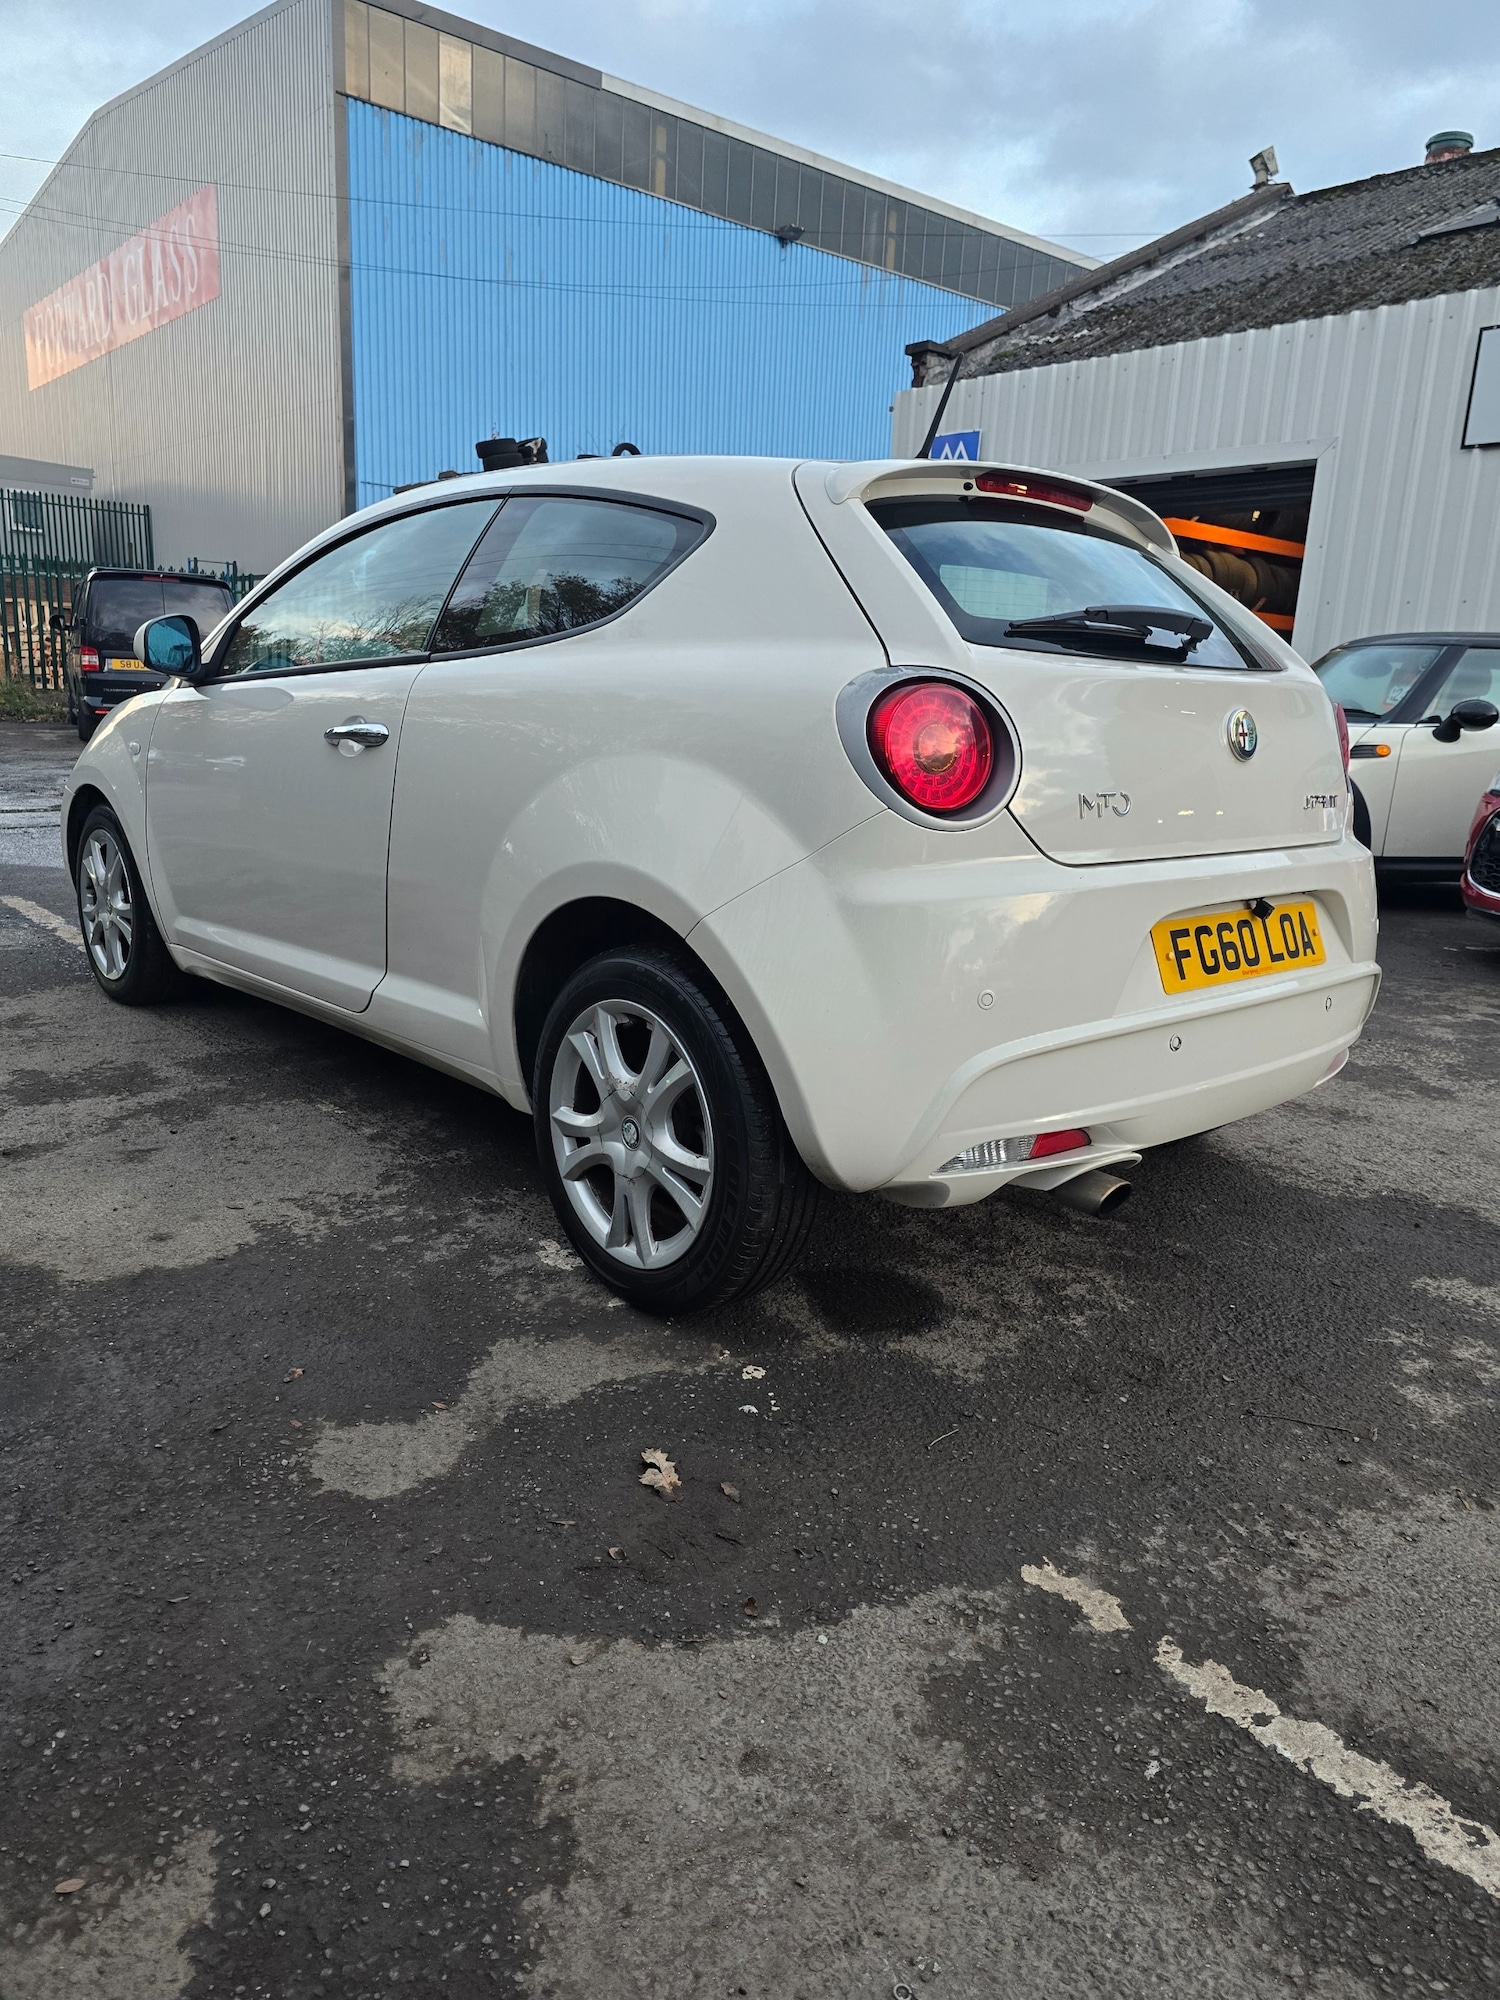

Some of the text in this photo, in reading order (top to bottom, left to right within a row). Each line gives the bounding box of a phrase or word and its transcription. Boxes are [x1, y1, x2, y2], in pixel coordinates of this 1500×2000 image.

[34, 213, 199, 374] FORWARD GLASS
[120, 660, 132, 669] S8
[1169, 911, 1316, 981] FG60 LOA
